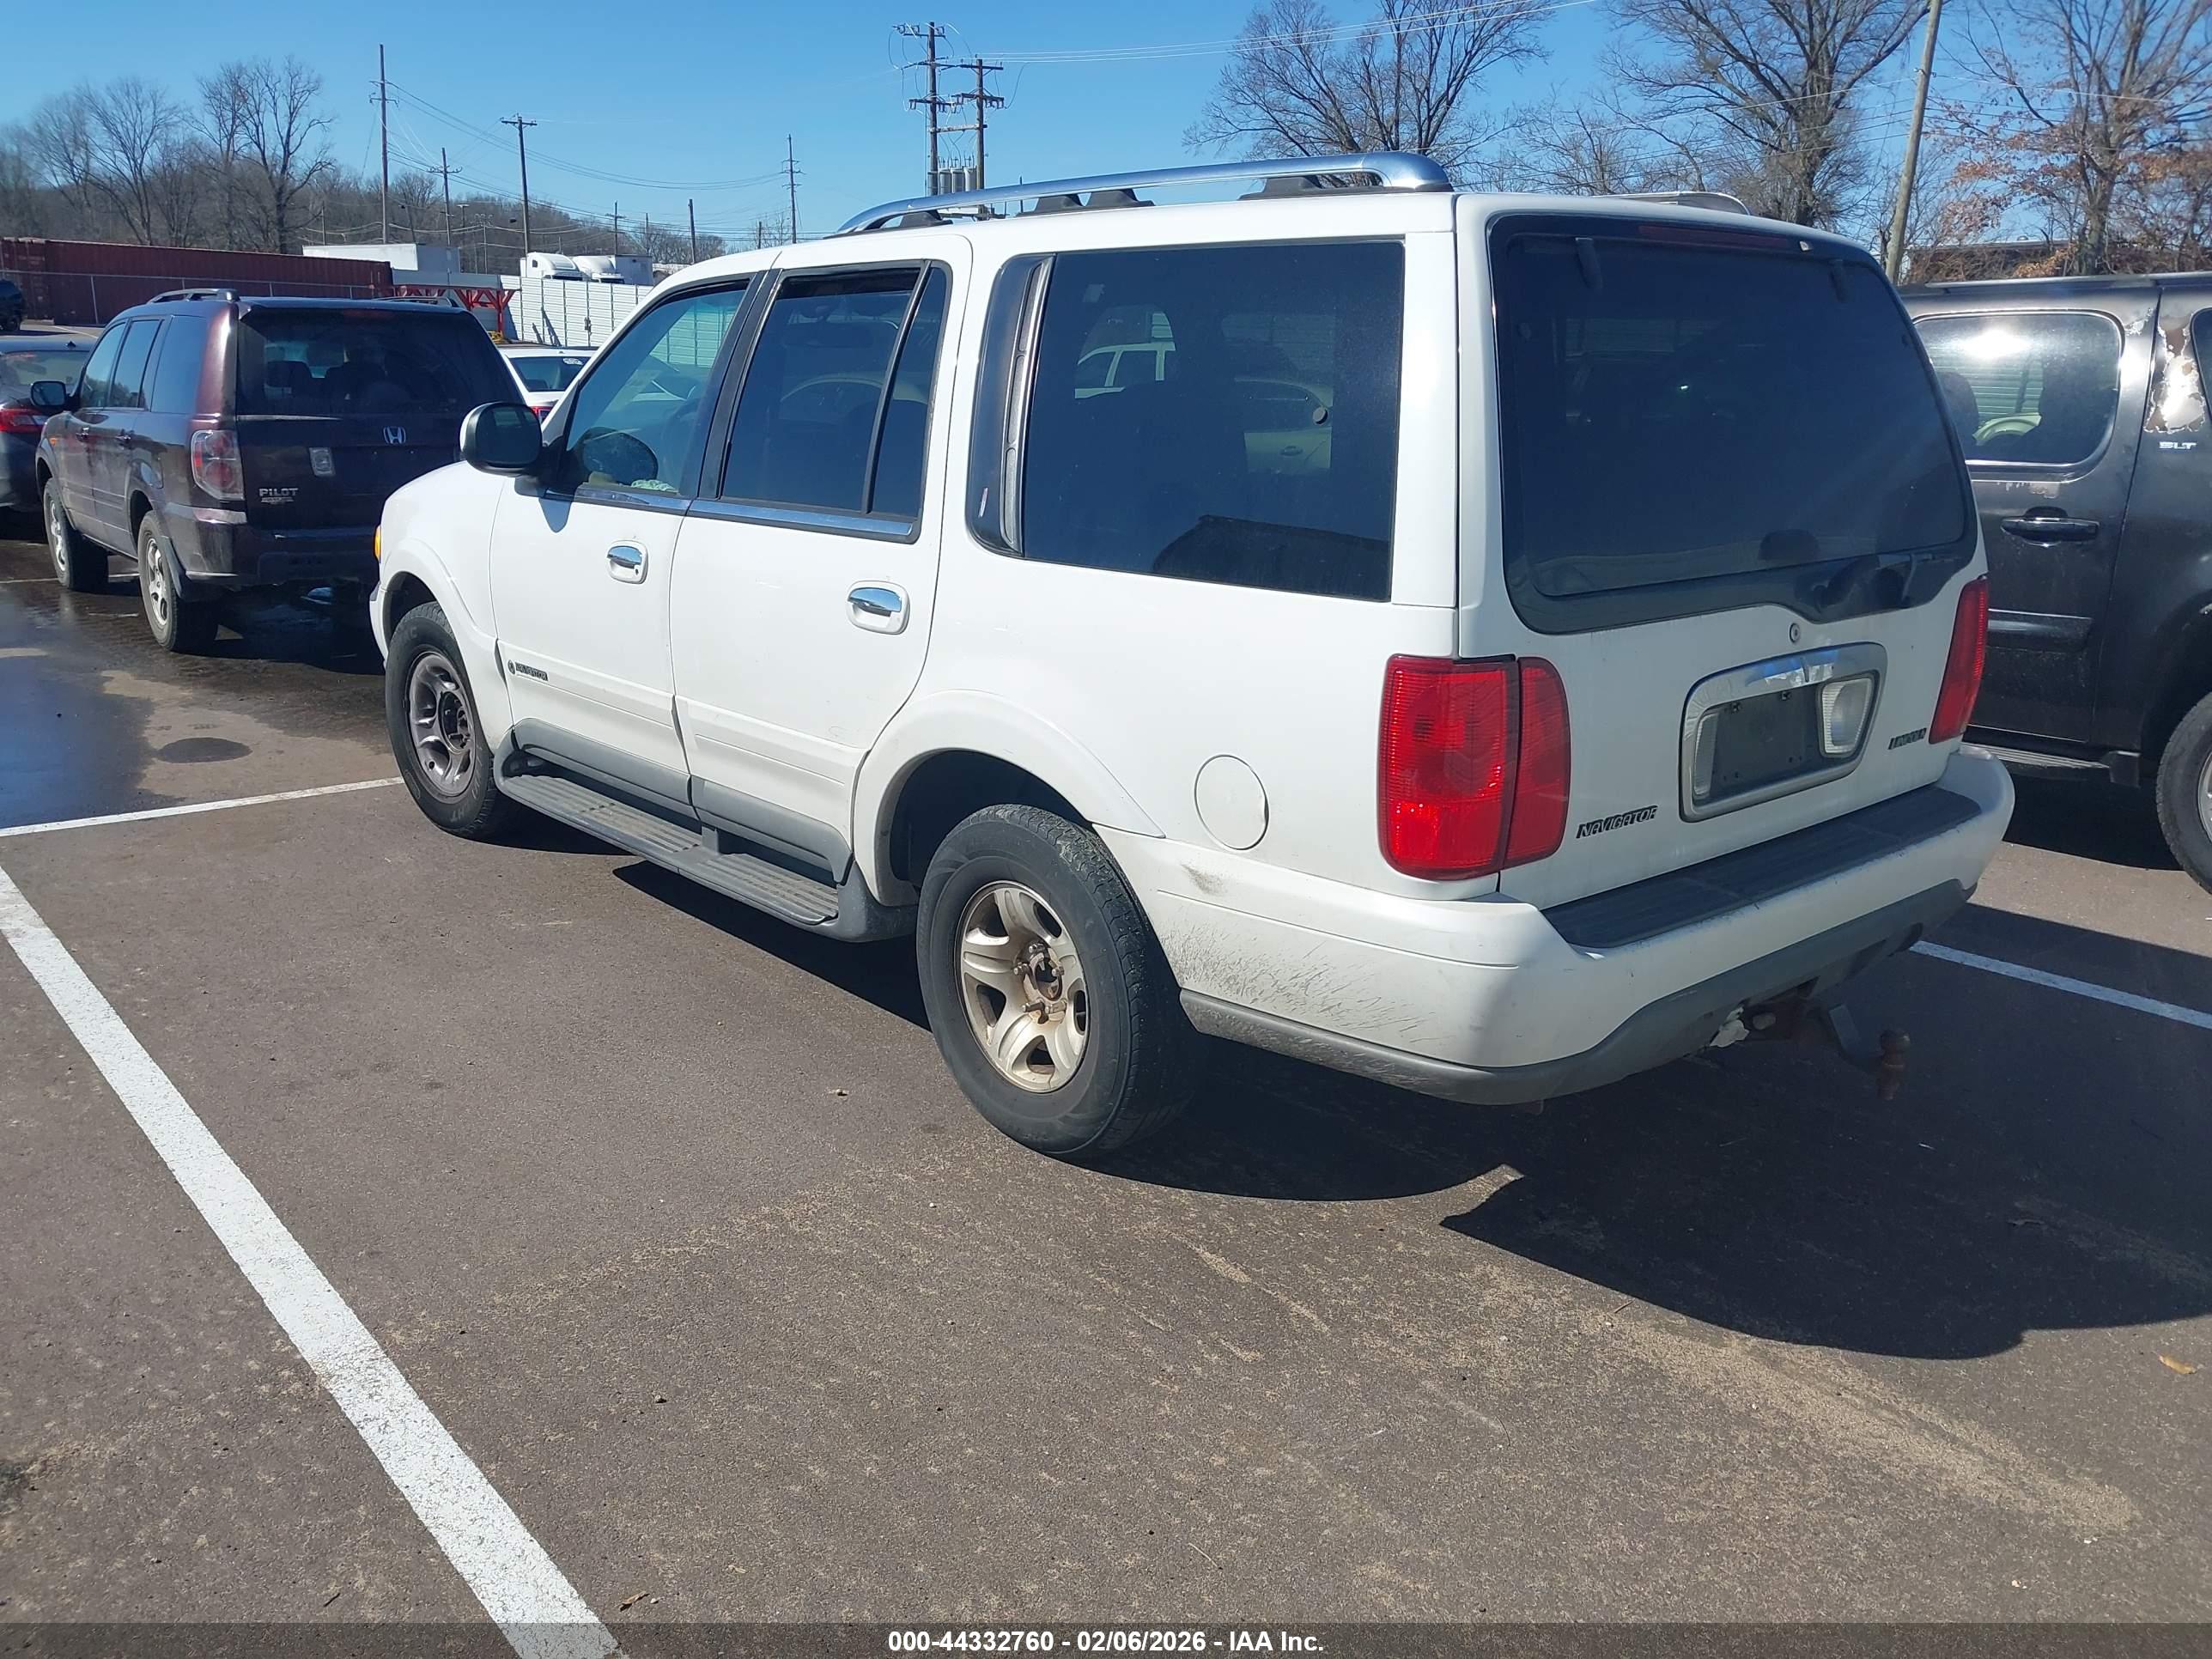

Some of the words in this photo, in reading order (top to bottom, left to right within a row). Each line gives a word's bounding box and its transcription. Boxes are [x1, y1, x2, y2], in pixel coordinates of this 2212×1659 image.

[2159, 441, 2197, 450] SLT
[258, 488, 299, 496] PILOT
[1575, 805, 1659, 839] NAVIGATOR
